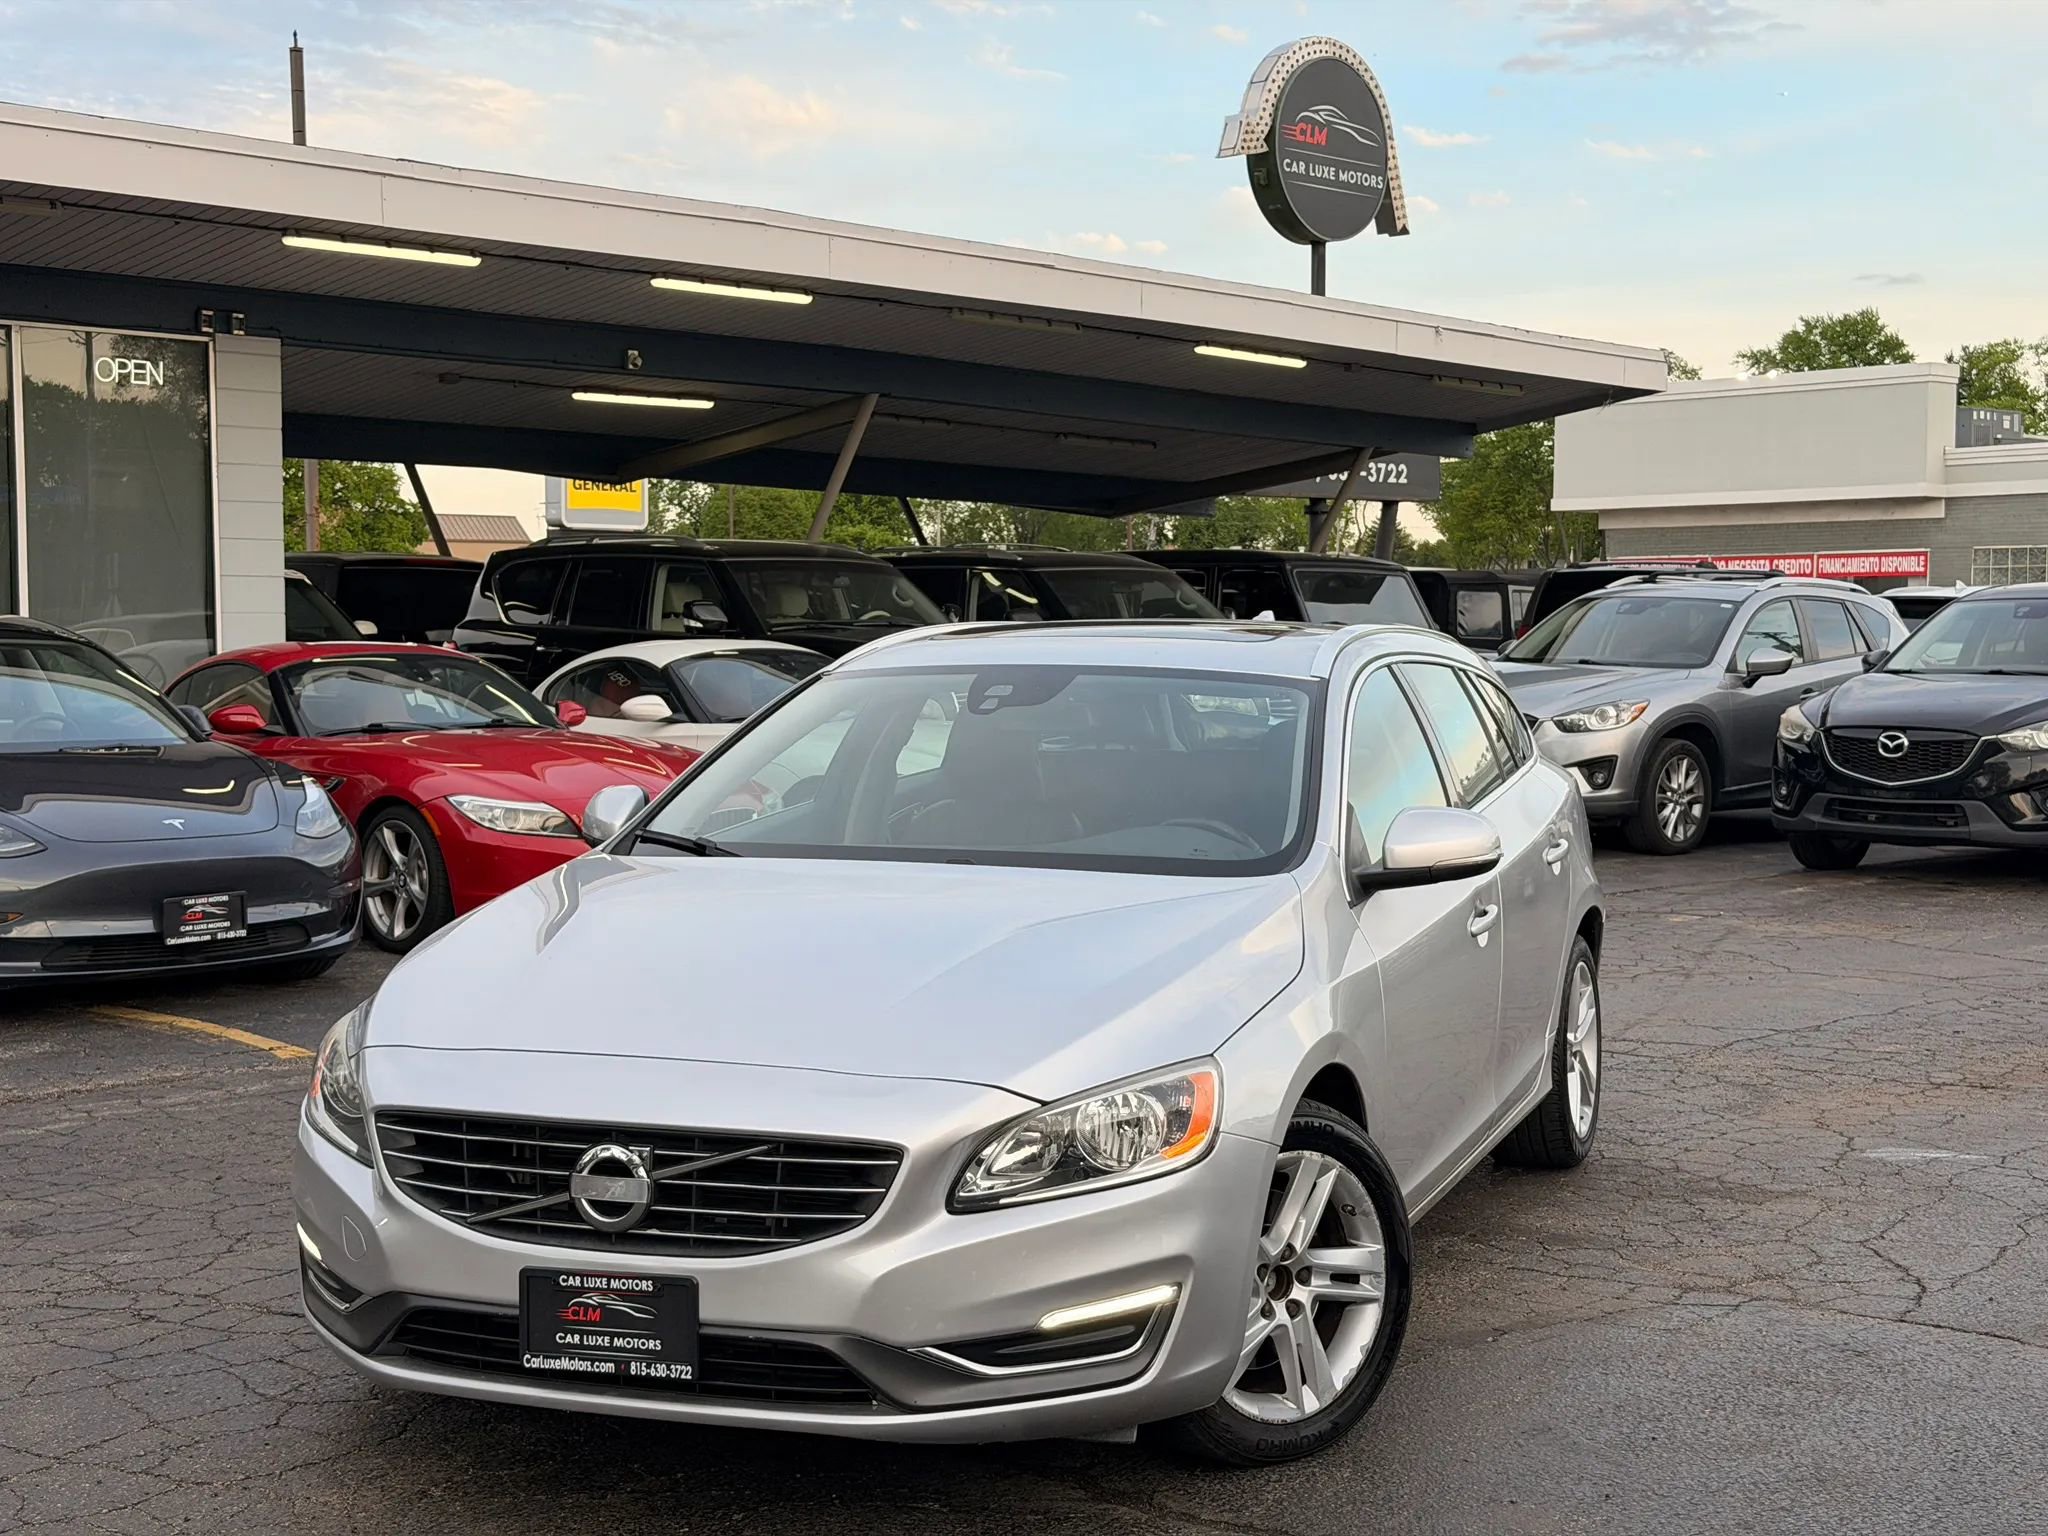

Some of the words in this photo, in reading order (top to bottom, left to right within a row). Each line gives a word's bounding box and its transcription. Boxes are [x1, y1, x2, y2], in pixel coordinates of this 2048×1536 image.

[1295, 122, 1328, 146] CLM
[1282, 158, 1305, 175] CAR
[1309, 164, 1336, 181] LUXE
[1339, 170, 1384, 189] MOTORS
[95, 356, 164, 386] OPEN
[1772, 558, 1812, 575] CREDITO
[1818, 556, 1880, 574] FINANCIAMIENTO
[1880, 555, 1926, 573] DISPONIBLE
[208, 895, 229, 903] MOTORS
[194, 923, 208, 931] LUXE
[208, 921, 231, 929] MOTORS
[559, 1275, 581, 1287] CAR
[583, 1276, 608, 1289] LUXE
[610, 1278, 654, 1292] MOTORS
[568, 1306, 602, 1322] CLM
[555, 1332, 581, 1345] CAR
[583, 1335, 611, 1347] LUXE
[613, 1337, 662, 1351] MOTORS
[523, 1354, 615, 1374] CarLuxeMotors.com
[630, 1361, 692, 1380] 815-630-3722
